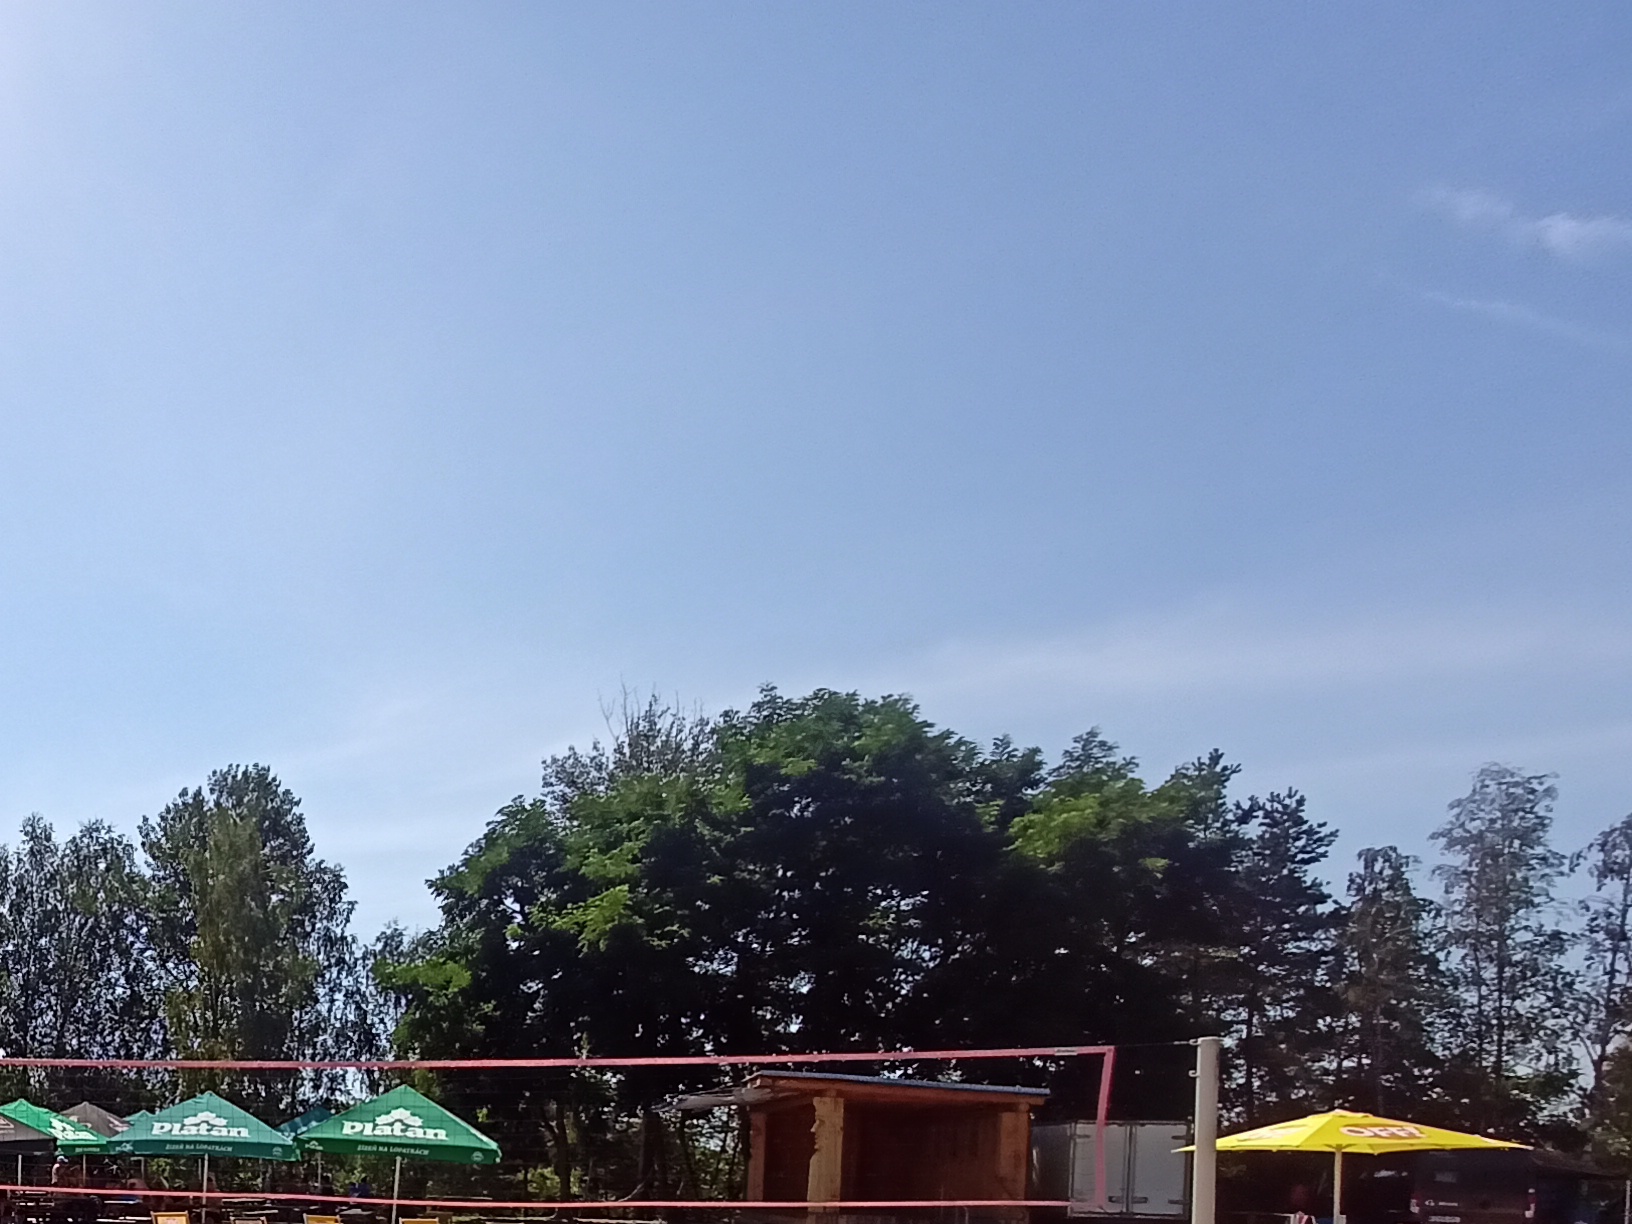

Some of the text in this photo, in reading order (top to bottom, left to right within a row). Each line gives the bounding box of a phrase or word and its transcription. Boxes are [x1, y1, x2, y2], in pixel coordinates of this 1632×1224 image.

[151, 1121, 251, 1138] Platan
[342, 1120, 449, 1141] Platan
[1339, 1126, 1427, 1139] OFF!
